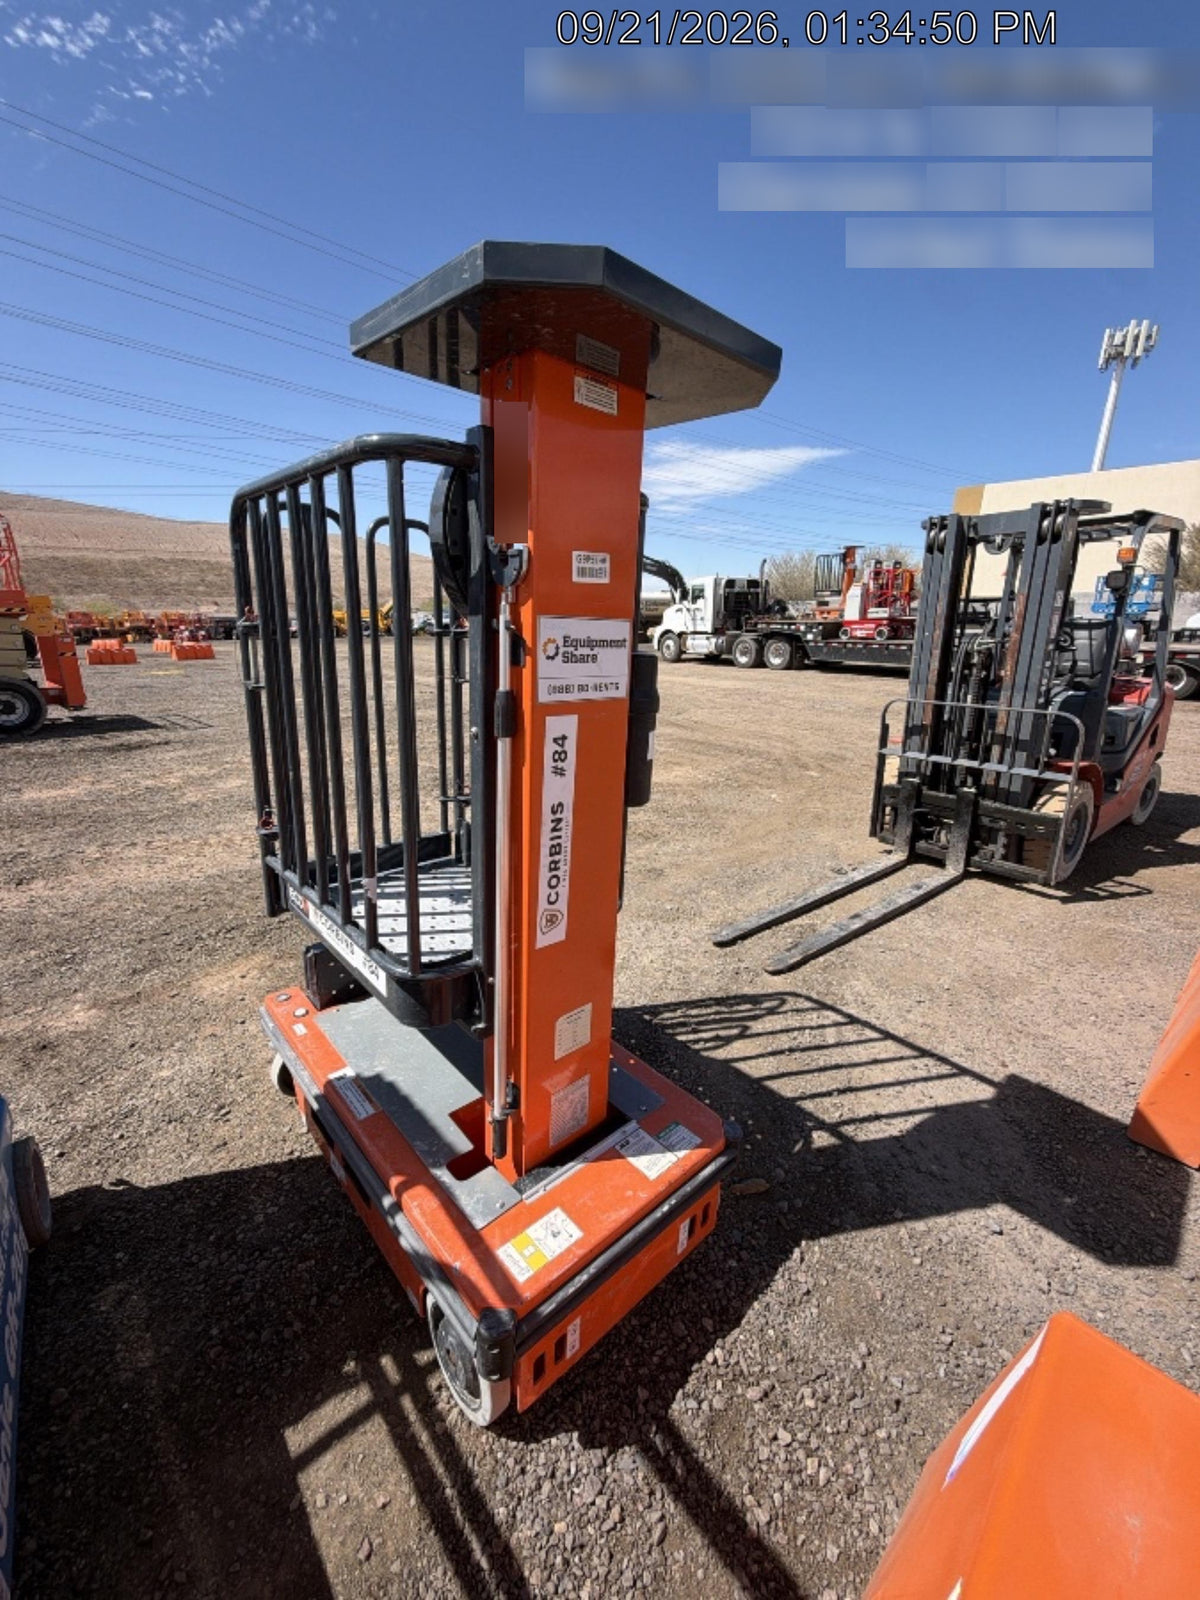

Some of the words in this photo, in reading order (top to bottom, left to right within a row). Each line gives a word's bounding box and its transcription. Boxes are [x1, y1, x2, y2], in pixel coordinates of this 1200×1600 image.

[561, 650, 598, 664] Share
[563, 635, 627, 651] Equipment
[551, 734, 568, 777] #84
[547, 801, 564, 905] CORBINS
